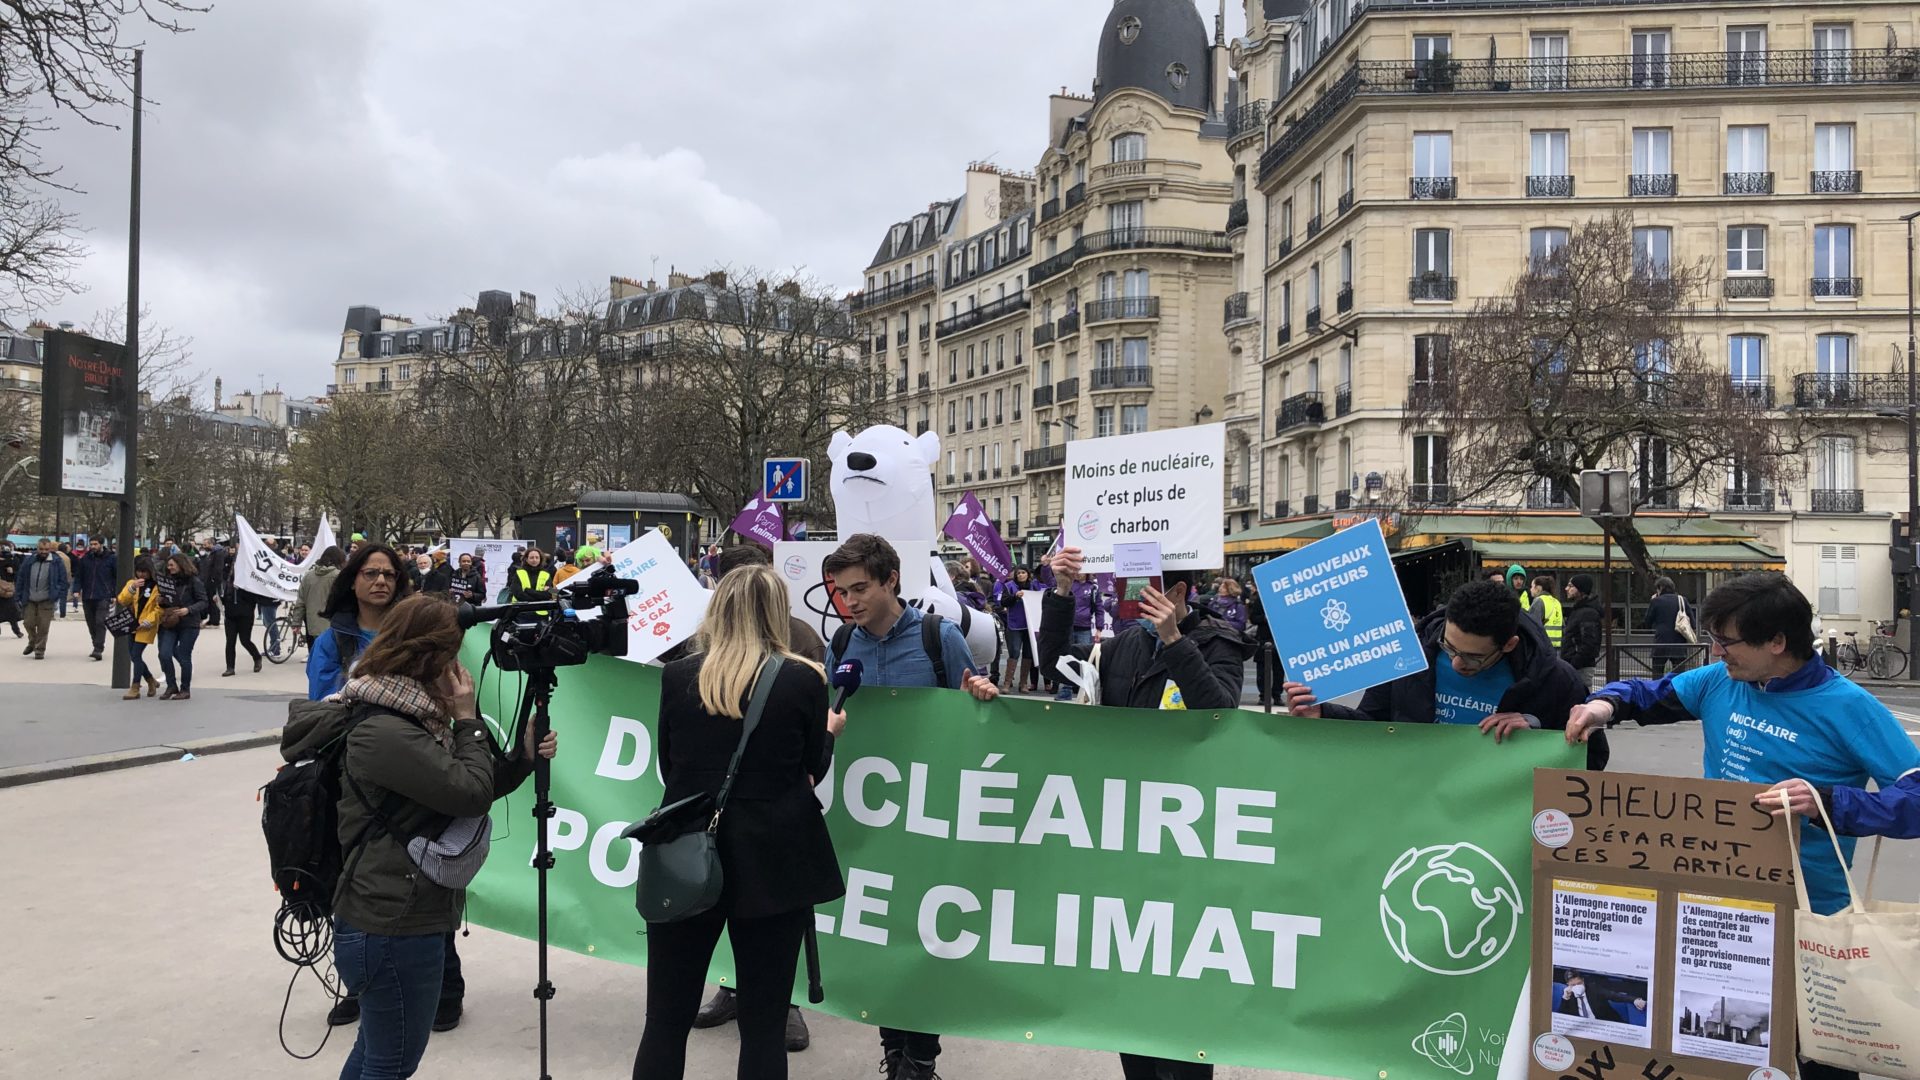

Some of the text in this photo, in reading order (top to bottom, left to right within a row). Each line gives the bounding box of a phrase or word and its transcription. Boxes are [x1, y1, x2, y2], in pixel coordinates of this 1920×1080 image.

[1071, 452, 1215, 480] Moins de nucléaire,
[1096, 483, 1186, 507] c'est plus de
[969, 524, 989, 546] Parti
[1110, 516, 1170, 534] charbon
[964, 533, 1009, 577] Animaliste
[1271, 544, 1372, 593] DE NOUVEAUX
[1284, 565, 1369, 607] RÉACTEURS
[638, 589, 669, 612] SENT
[631, 602, 674, 632] LE GAZ
[1288, 619, 1406, 669] POUR UN AVENIR
[1303, 639, 1403, 682] BAS-CARBONE
[1726, 726, 1747, 741] (adj.)
[1729, 712, 1799, 744] NUCLÉAIRE
[594, 715, 666, 787] D
[1600, 781, 1774, 831] HEURES
[1585, 824, 1751, 858] SÉPARENT
[1552, 847, 1609, 863] CES
[1628, 852, 1650, 870] 2
[528, 807, 643, 888] PO
[917, 884, 1322, 990] CLIMAT
[1555, 894, 1648, 915] L'Allemagne renonce
[1554, 904, 1643, 925] à la prolongation de
[1554, 917, 1613, 932] ses centrales
[1682, 916, 1750, 933] des centrales au
[1683, 905, 1734, 921] L'Allemagne
[1735, 912, 1770, 925] réactive
[1554, 927, 1600, 942] nucléaires
[1681, 937, 1718, 949] menaces
[1682, 926, 1753, 943] charbon face aux
[1681, 946, 1771, 967] d'approvisionnement
[1799, 939, 1871, 960] NUCLÉAIRE
[1681, 957, 1732, 971] en gaz russe
[1869, 1041, 1894, 1050] attend
